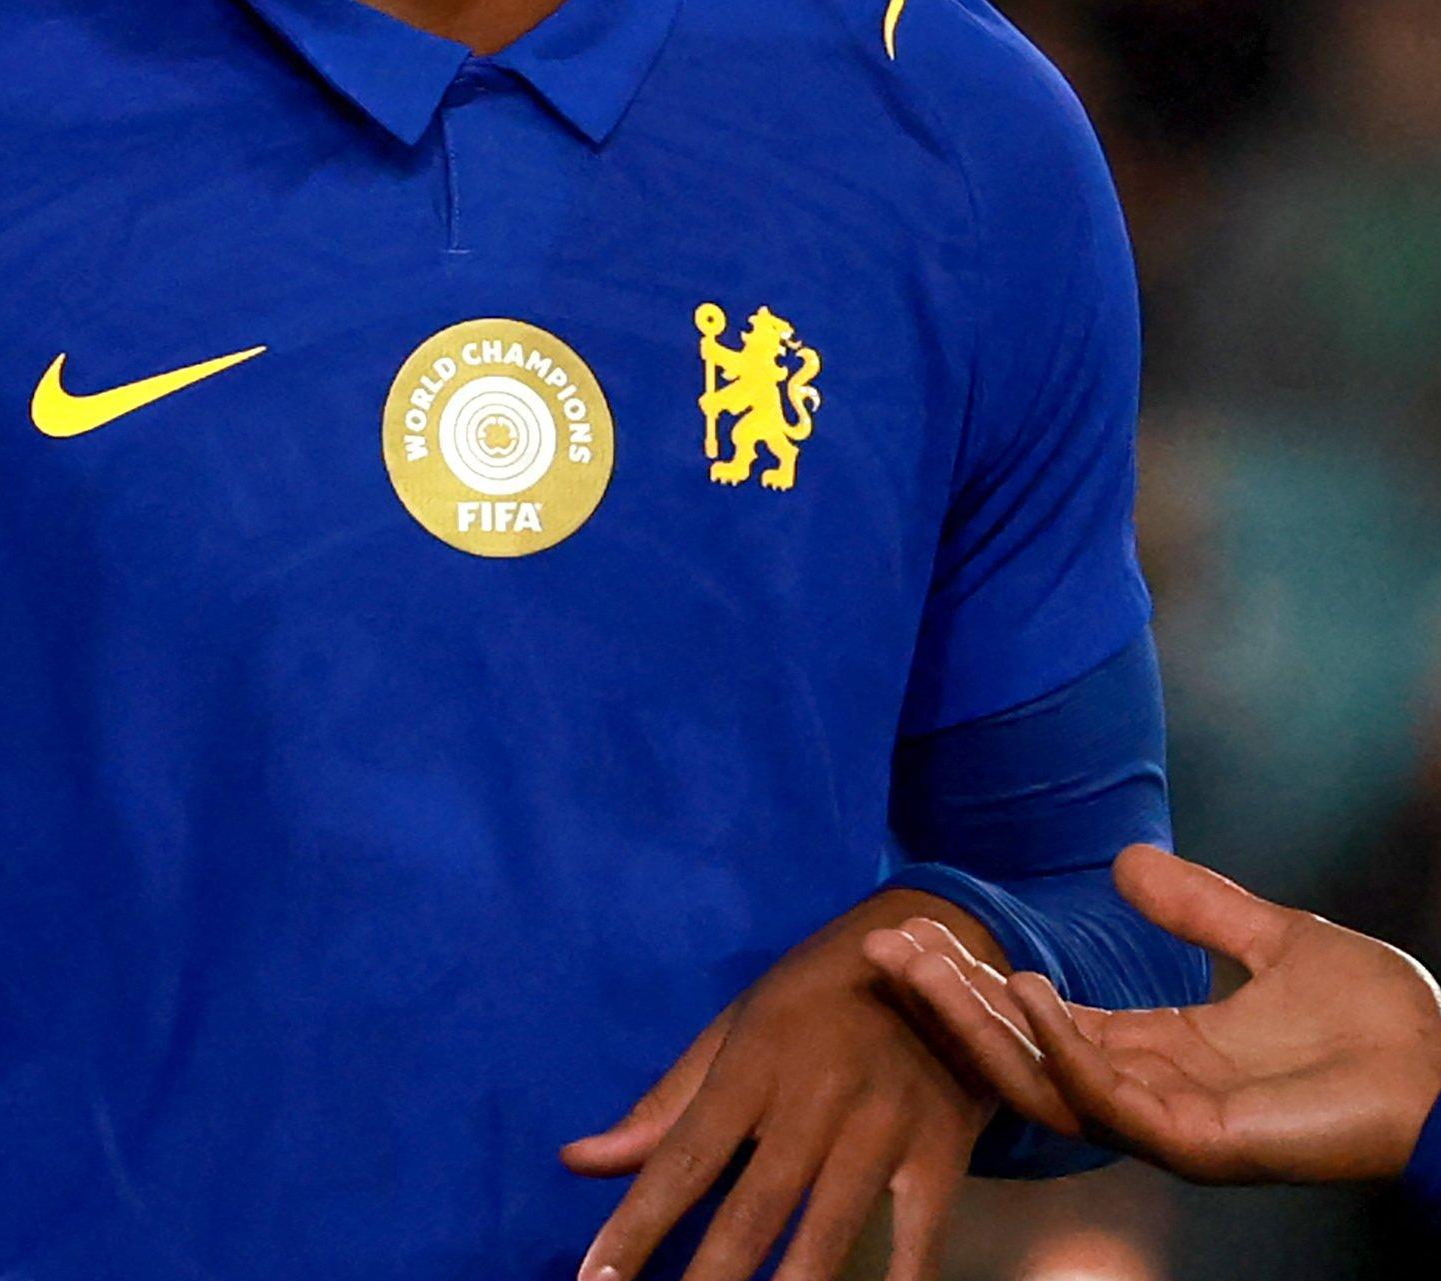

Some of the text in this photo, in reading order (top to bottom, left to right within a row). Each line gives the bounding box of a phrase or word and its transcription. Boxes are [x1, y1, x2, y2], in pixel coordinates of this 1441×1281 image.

[403, 339, 593, 465] WORLD CHAMPIONS
[456, 501, 543, 532] FIFA
